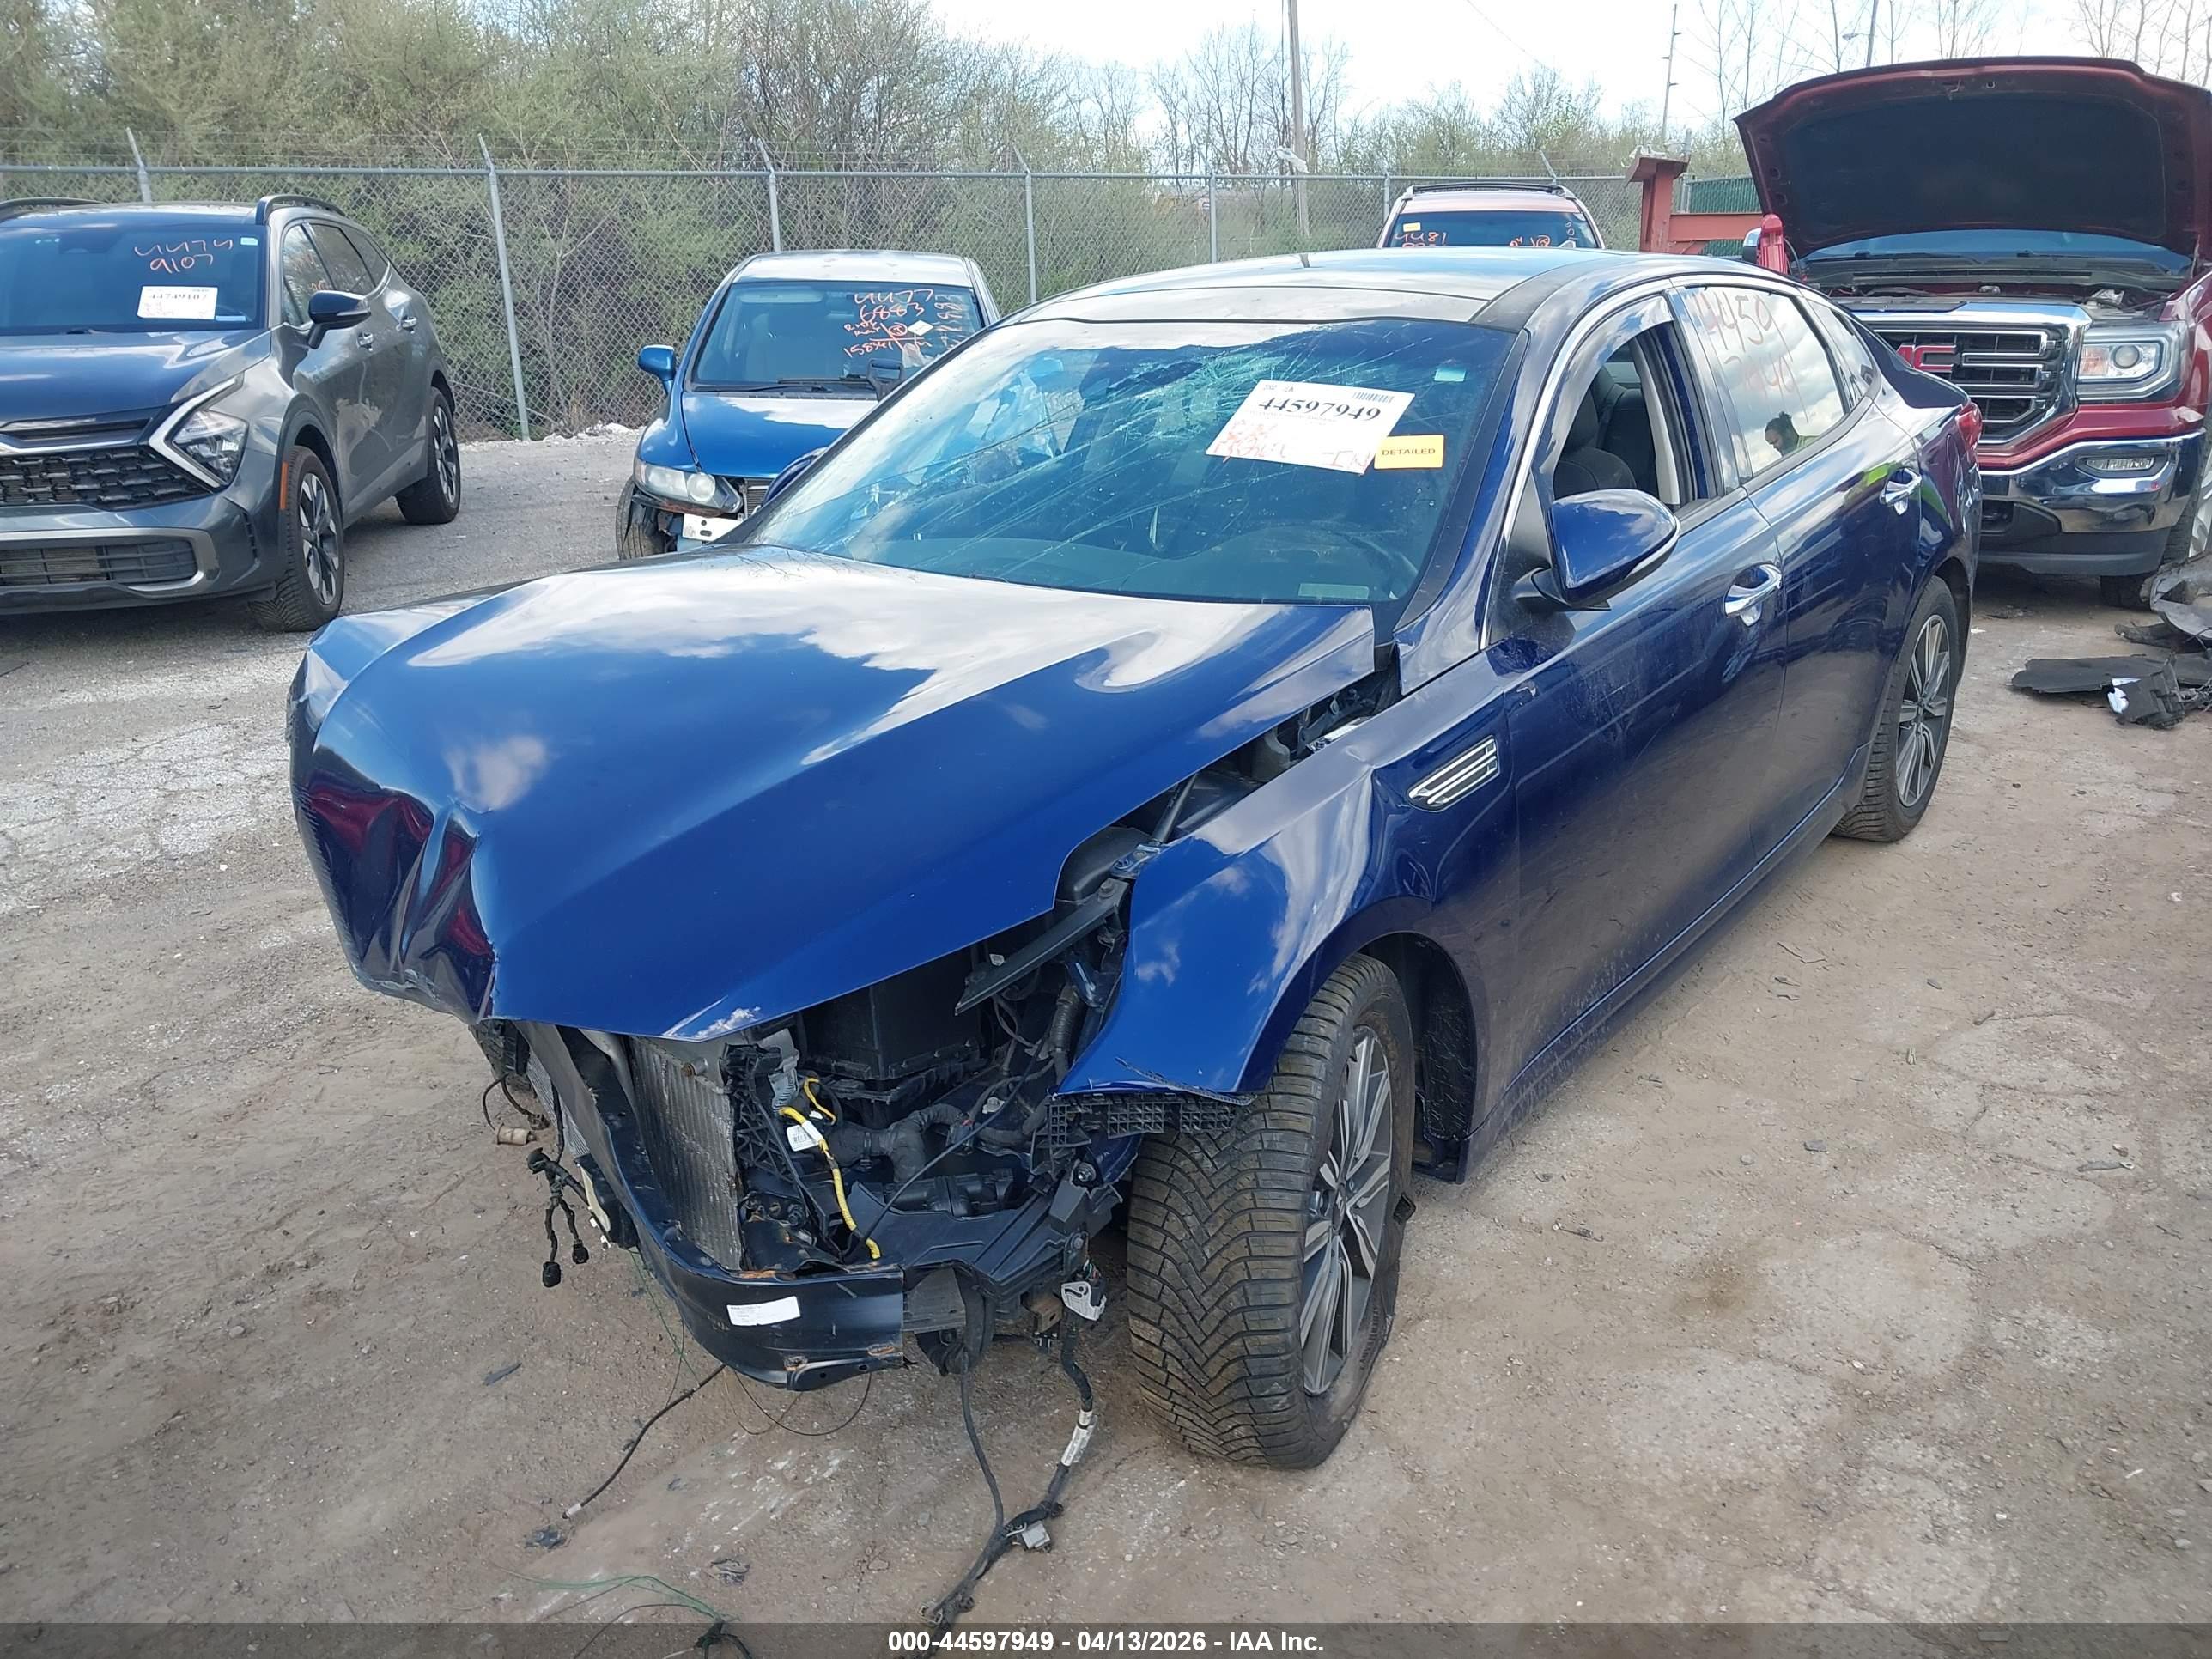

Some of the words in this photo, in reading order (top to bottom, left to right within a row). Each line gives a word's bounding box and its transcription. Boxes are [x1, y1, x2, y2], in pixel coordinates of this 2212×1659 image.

[149, 253, 214, 274] 9107
[854, 289, 934, 304] 4477
[860, 302, 924, 324] 6883
[1258, 397, 1382, 422] 44597949
